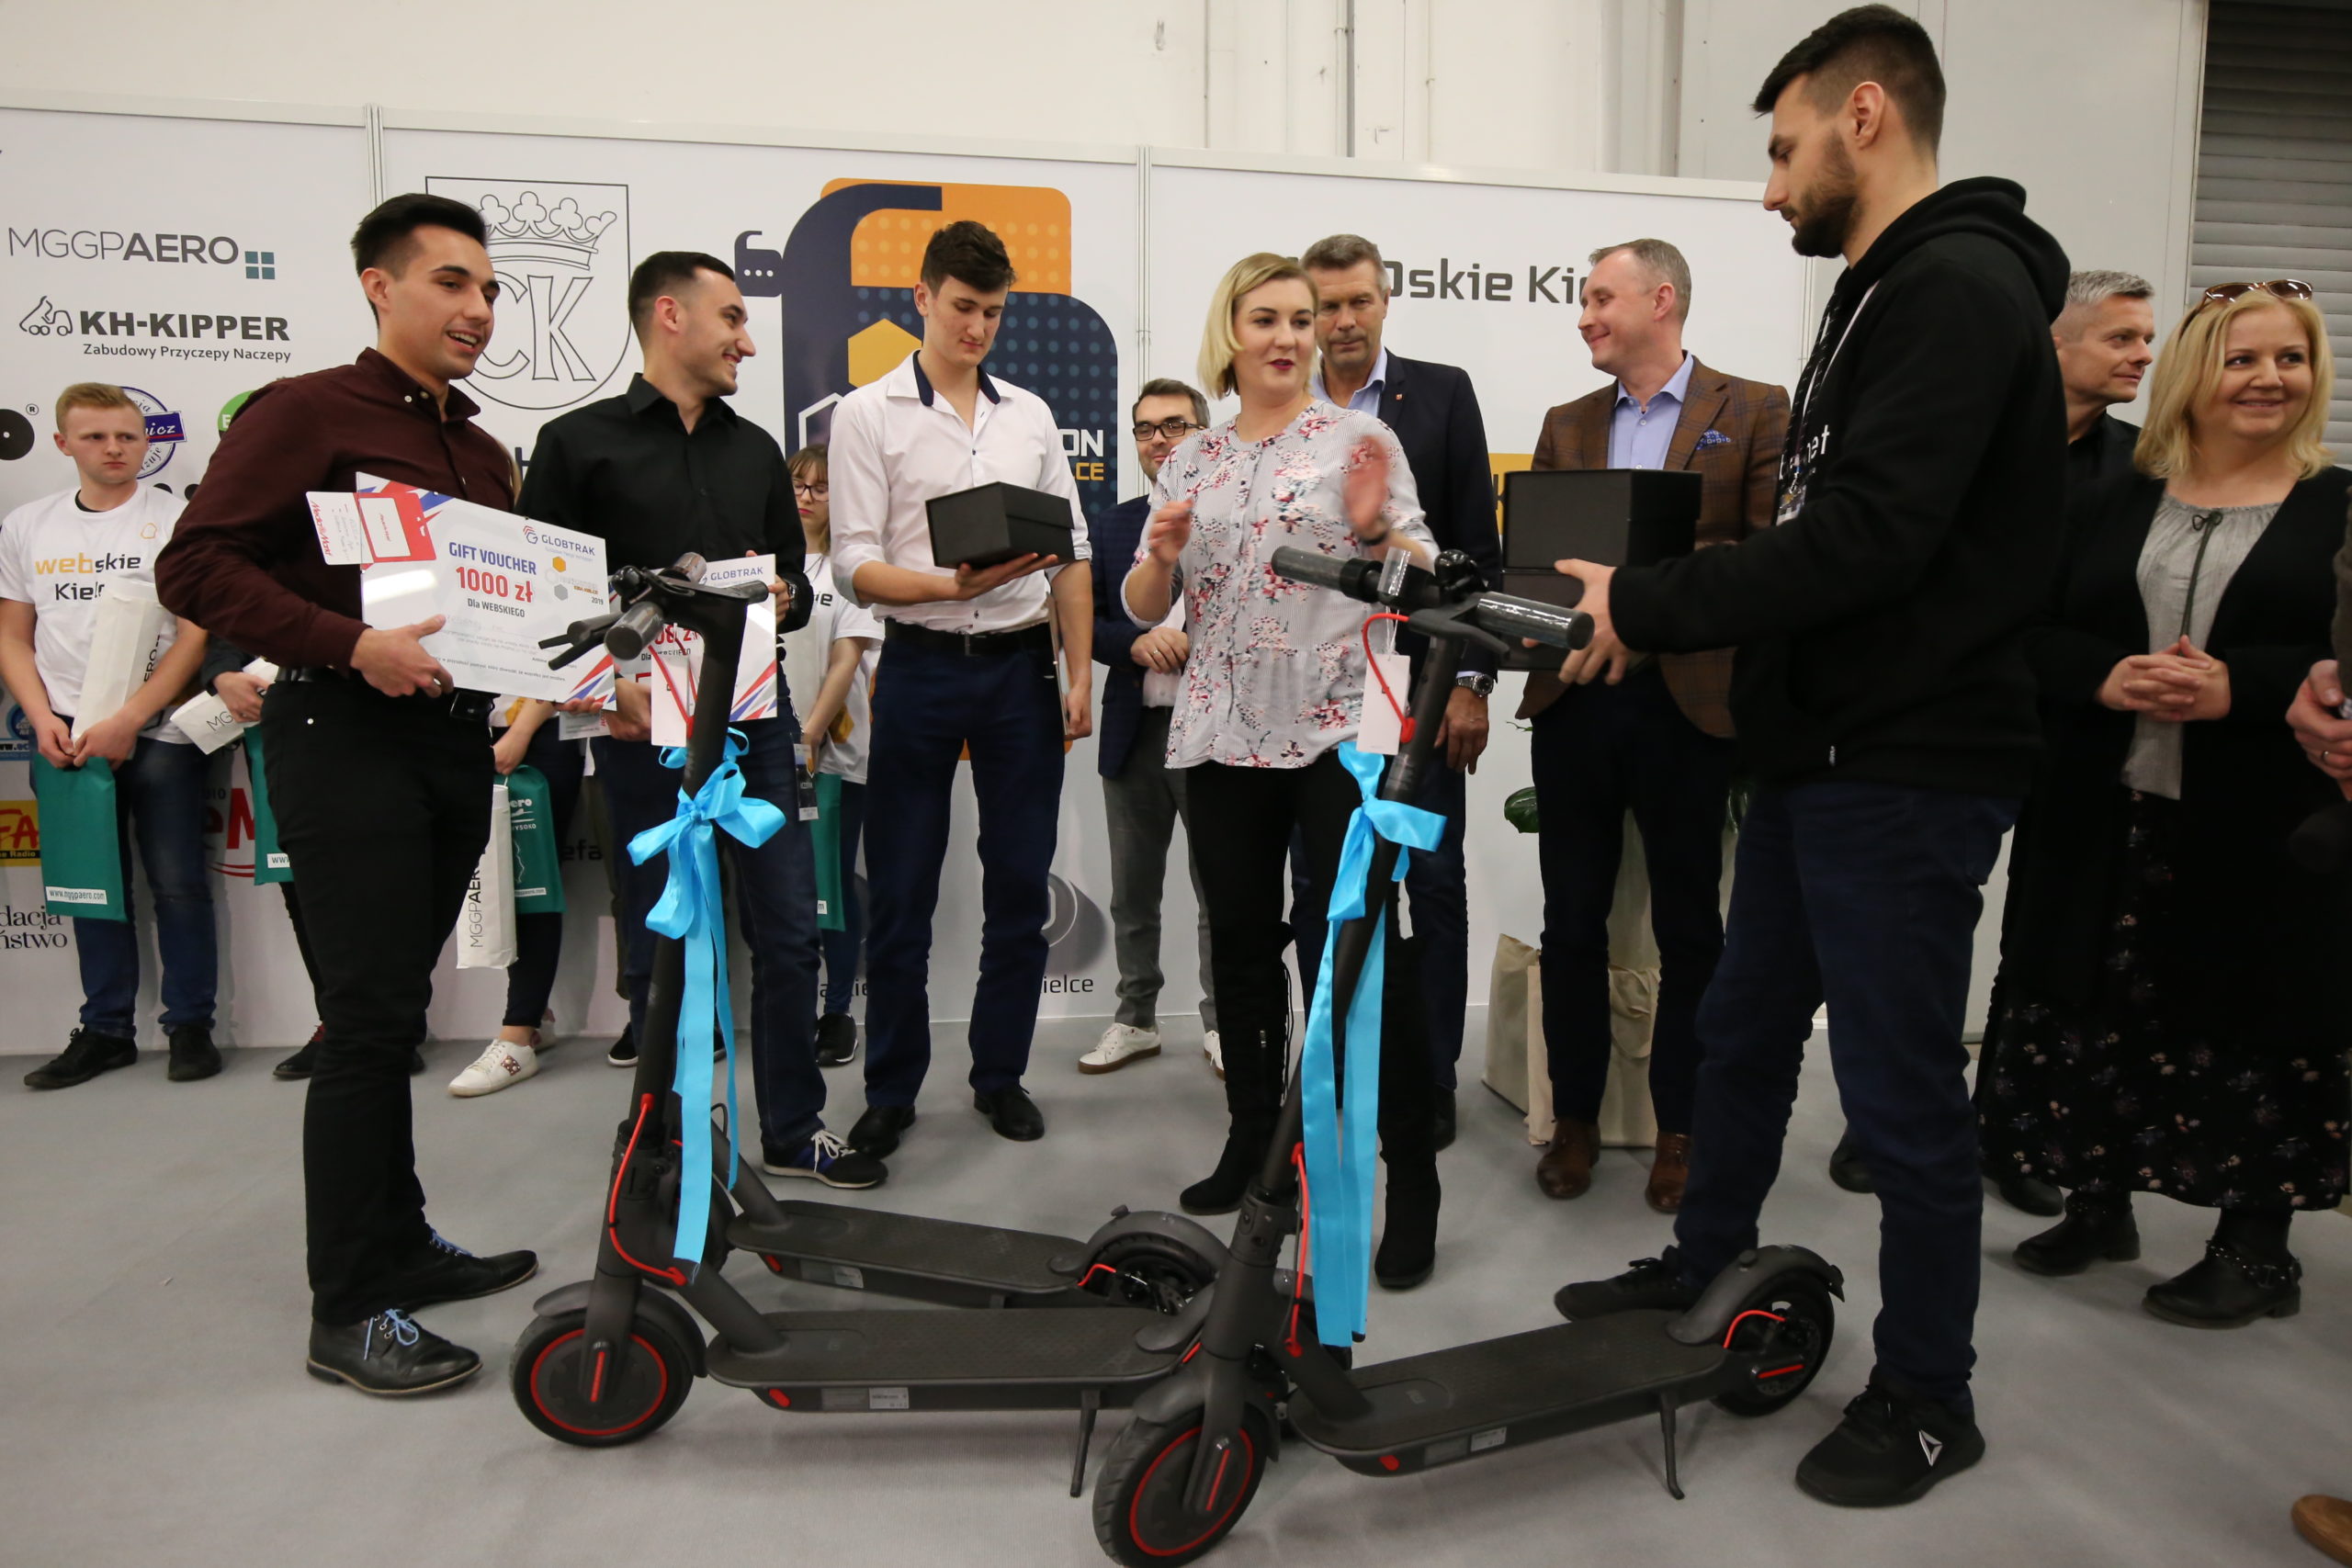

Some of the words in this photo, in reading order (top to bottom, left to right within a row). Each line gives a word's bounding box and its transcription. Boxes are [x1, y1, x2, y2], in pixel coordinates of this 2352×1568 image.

[8, 227, 239, 265] MGGPAERO
[1529, 265, 1589, 304] Ki
[80, 310, 290, 341] KH-KIPPER
[83, 344, 157, 359] Zabudowy
[160, 345, 230, 361] Przyczepy
[233, 348, 291, 363] Naczepy
[1058, 428, 1104, 457] ON
[1075, 462, 1104, 481] CE
[541, 535, 595, 556] GLOBTRAK
[35, 552, 141, 575] webskie
[448, 542, 478, 560] GIFT
[480, 548, 537, 575] VOUCHER
[456, 566, 509, 598] 1000
[514, 581, 533, 603] zł
[710, 567, 763, 581] GLOBTRAK
[467, 598, 481, 608] Dla
[481, 602, 526, 618] WEBSKIEGO
[207, 711, 233, 731] MG
[510, 798, 533, 807] ero
[0, 905, 62, 931] dacja
[0, 930, 68, 950] ństwo
[1042, 975, 1094, 995] ielce
